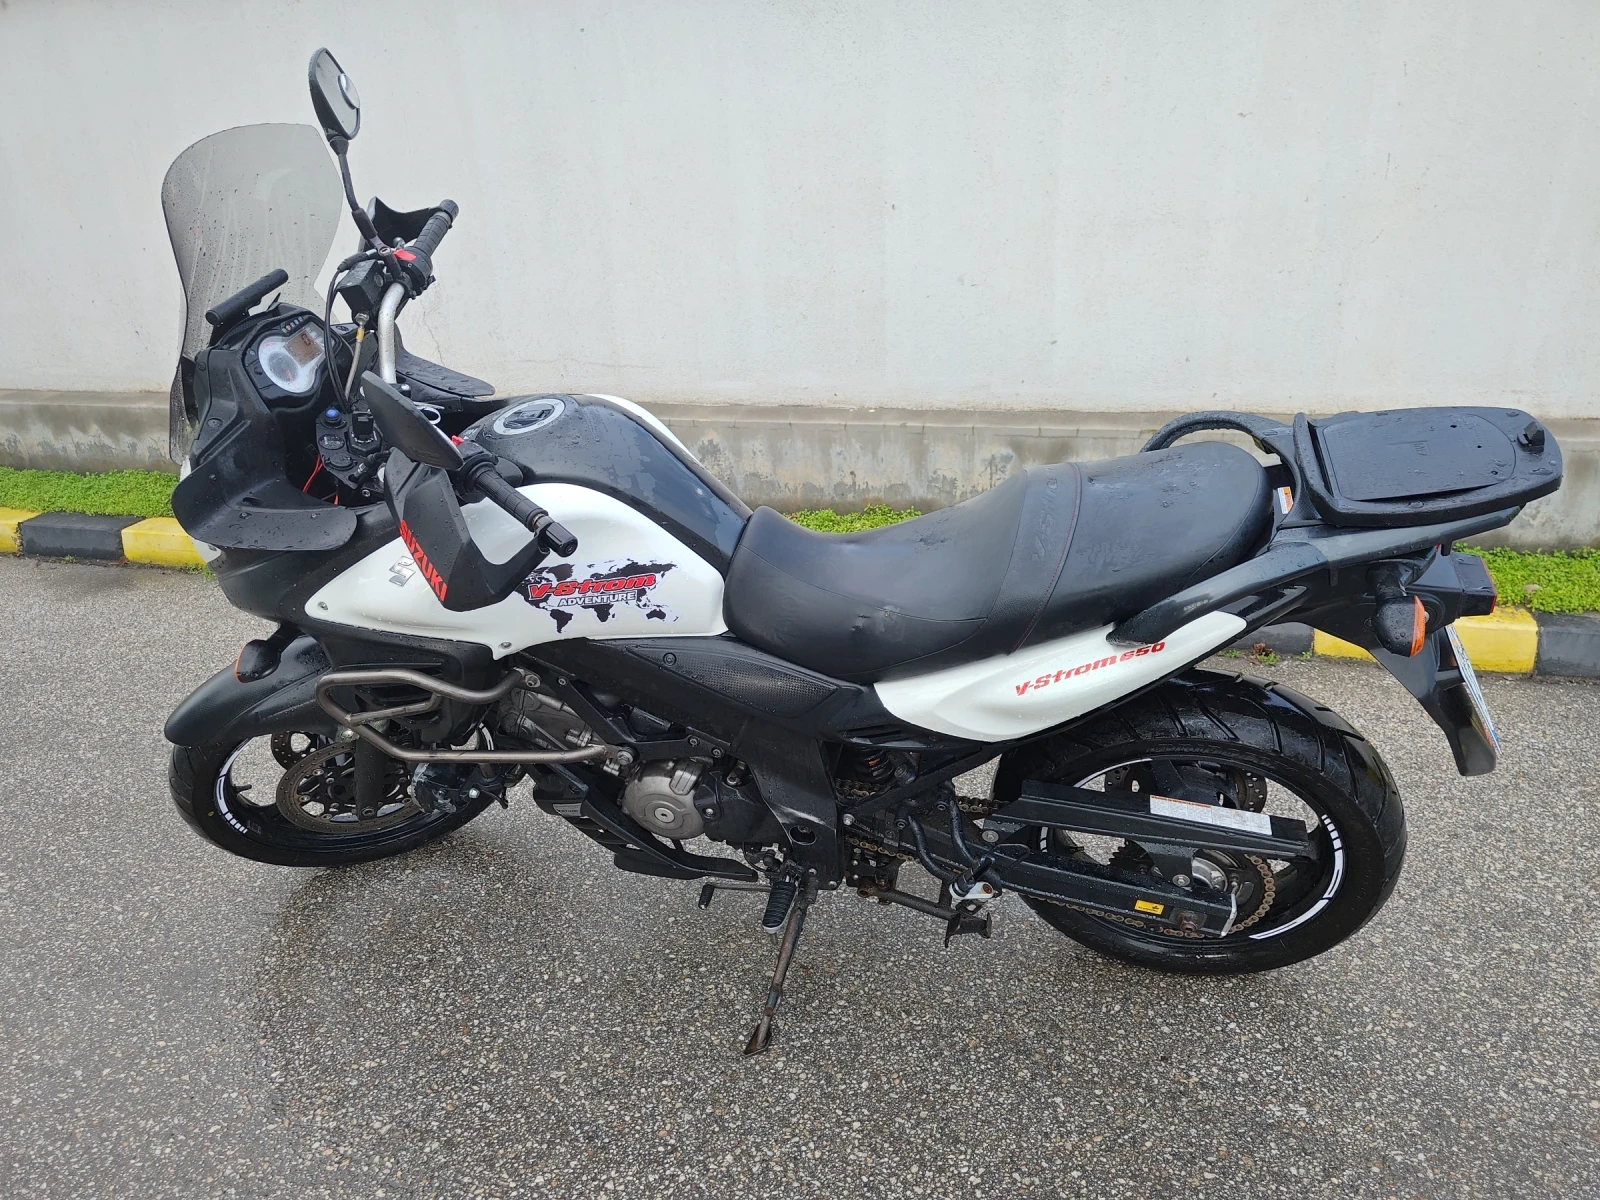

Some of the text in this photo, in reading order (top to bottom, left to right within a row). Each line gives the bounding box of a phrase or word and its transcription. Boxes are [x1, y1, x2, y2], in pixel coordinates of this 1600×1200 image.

[400, 520, 448, 601] SUZUKI
[529, 574, 657, 599] V-Strom
[558, 591, 637, 607] ADVENTURE
